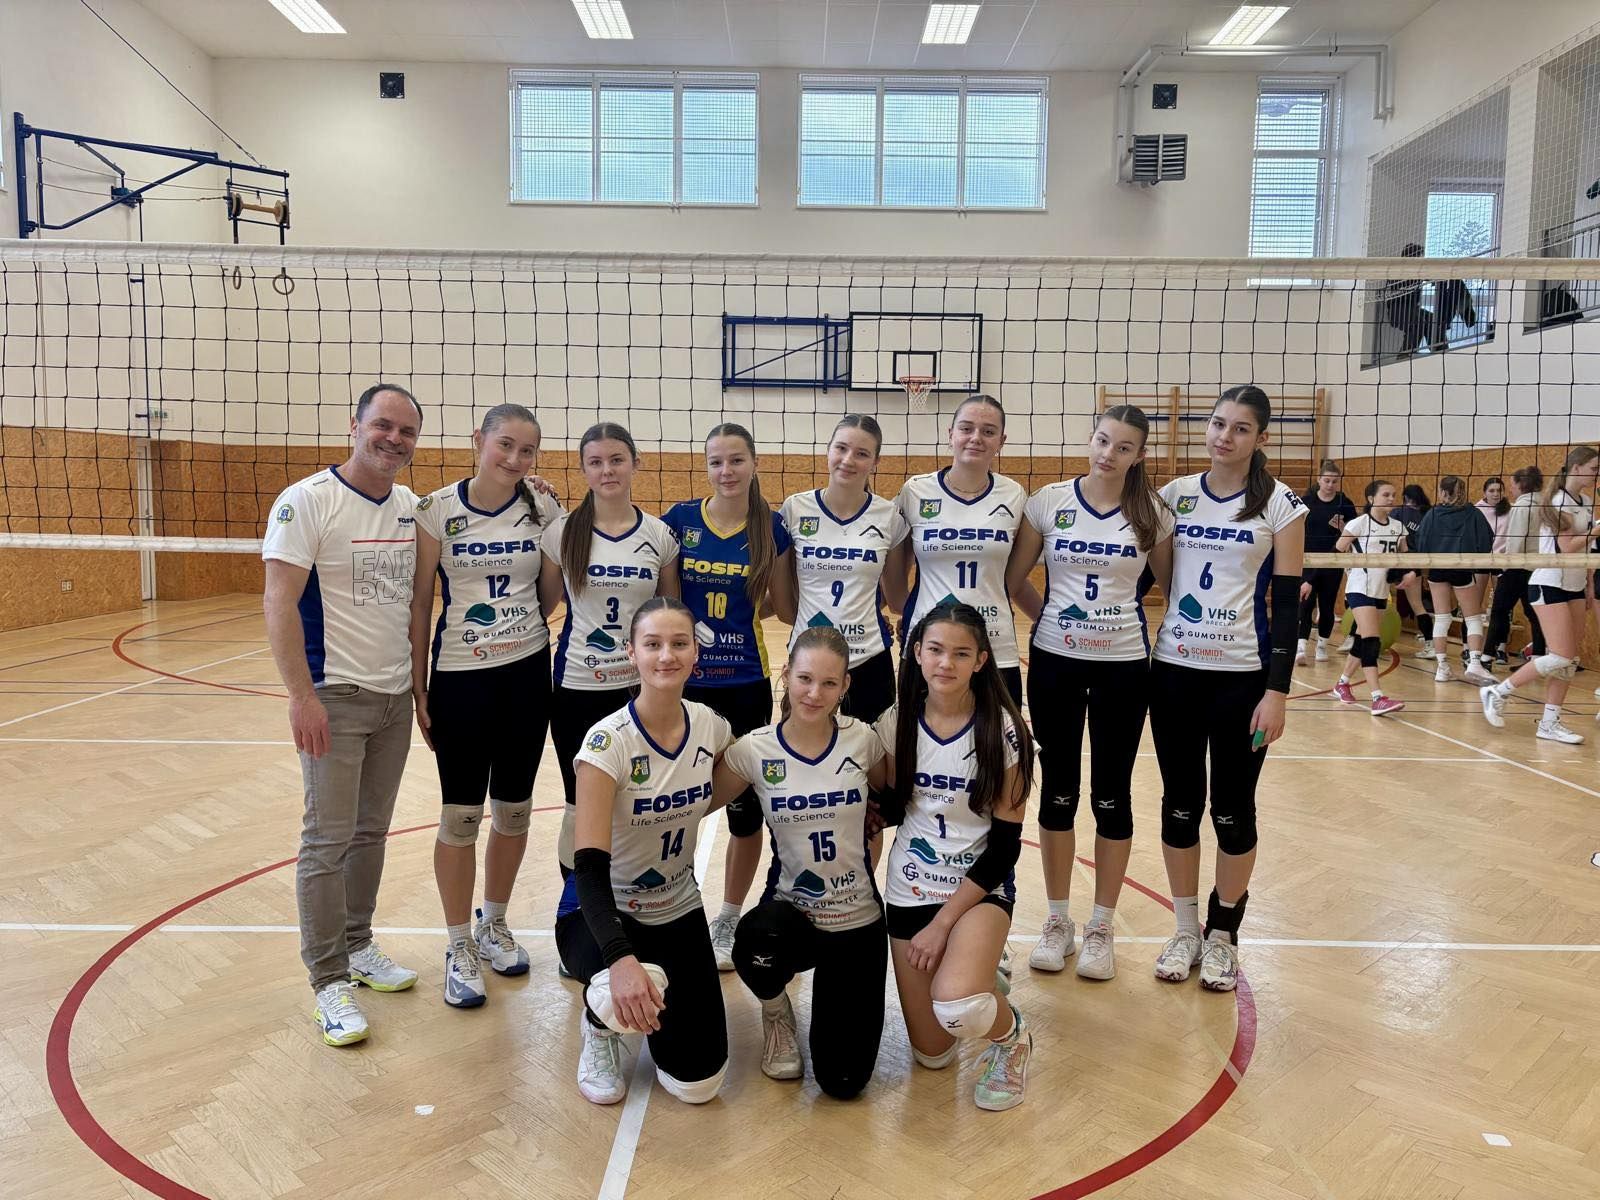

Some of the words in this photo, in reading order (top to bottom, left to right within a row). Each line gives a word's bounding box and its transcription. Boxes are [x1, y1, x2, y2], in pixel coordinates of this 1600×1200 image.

[923, 528, 1009, 543] FOSFA
[1174, 524, 1255, 544] FOSFA
[452, 540, 537, 556] FOSFA
[923, 543, 939, 552] Life
[941, 543, 984, 552] Science
[1054, 538, 1138, 558] FOSFA
[1173, 540, 1186, 548] Life
[1187, 541, 1224, 551] Science
[802, 546, 878, 563] FOSFA
[1053, 553, 1068, 562] Life
[1070, 555, 1110, 567] Science
[352, 550, 416, 580] FAIR
[453, 559, 469, 568] Life
[471, 558, 513, 568] Science
[802, 562, 815, 570] Life
[817, 562, 853, 572] Science
[588, 564, 653, 580] OSFA
[955, 561, 978, 589] 11
[1199, 561, 1213, 590] 6
[485, 574, 511, 598] 12
[590, 580, 629, 588] Science
[696, 575, 732, 585] Science
[1085, 574, 1099, 601] 5
[831, 580, 845, 607] 9
[501, 606, 529, 618] VHS
[606, 597, 619, 623] 3
[705, 591, 728, 619] 10
[1095, 605, 1122, 616] VHS
[1208, 608, 1237, 620] VHS
[484, 625, 528, 639] GUMOTEX
[839, 624, 865, 635] VHS
[1187, 630, 1235, 642] GUMOTEX
[719, 633, 745, 644] VHS
[1078, 638, 1112, 648] SCHMIDT
[1191, 647, 1224, 657] SCHMIDT
[914, 772, 977, 793] OSF
[633, 782, 713, 815] FOSFA
[771, 788, 862, 812] FOSFA
[919, 790, 955, 804] Science
[631, 818, 652, 826] Life
[653, 809, 693, 824] Science
[773, 815, 790, 824] Life
[793, 812, 836, 823] Science
[934, 813, 946, 839] 1
[660, 827, 685, 861] 14
[808, 830, 836, 862] 15
[942, 853, 974, 864] VHS
[830, 870, 856, 889] VHS
[924, 872, 963, 884] GUMOT
